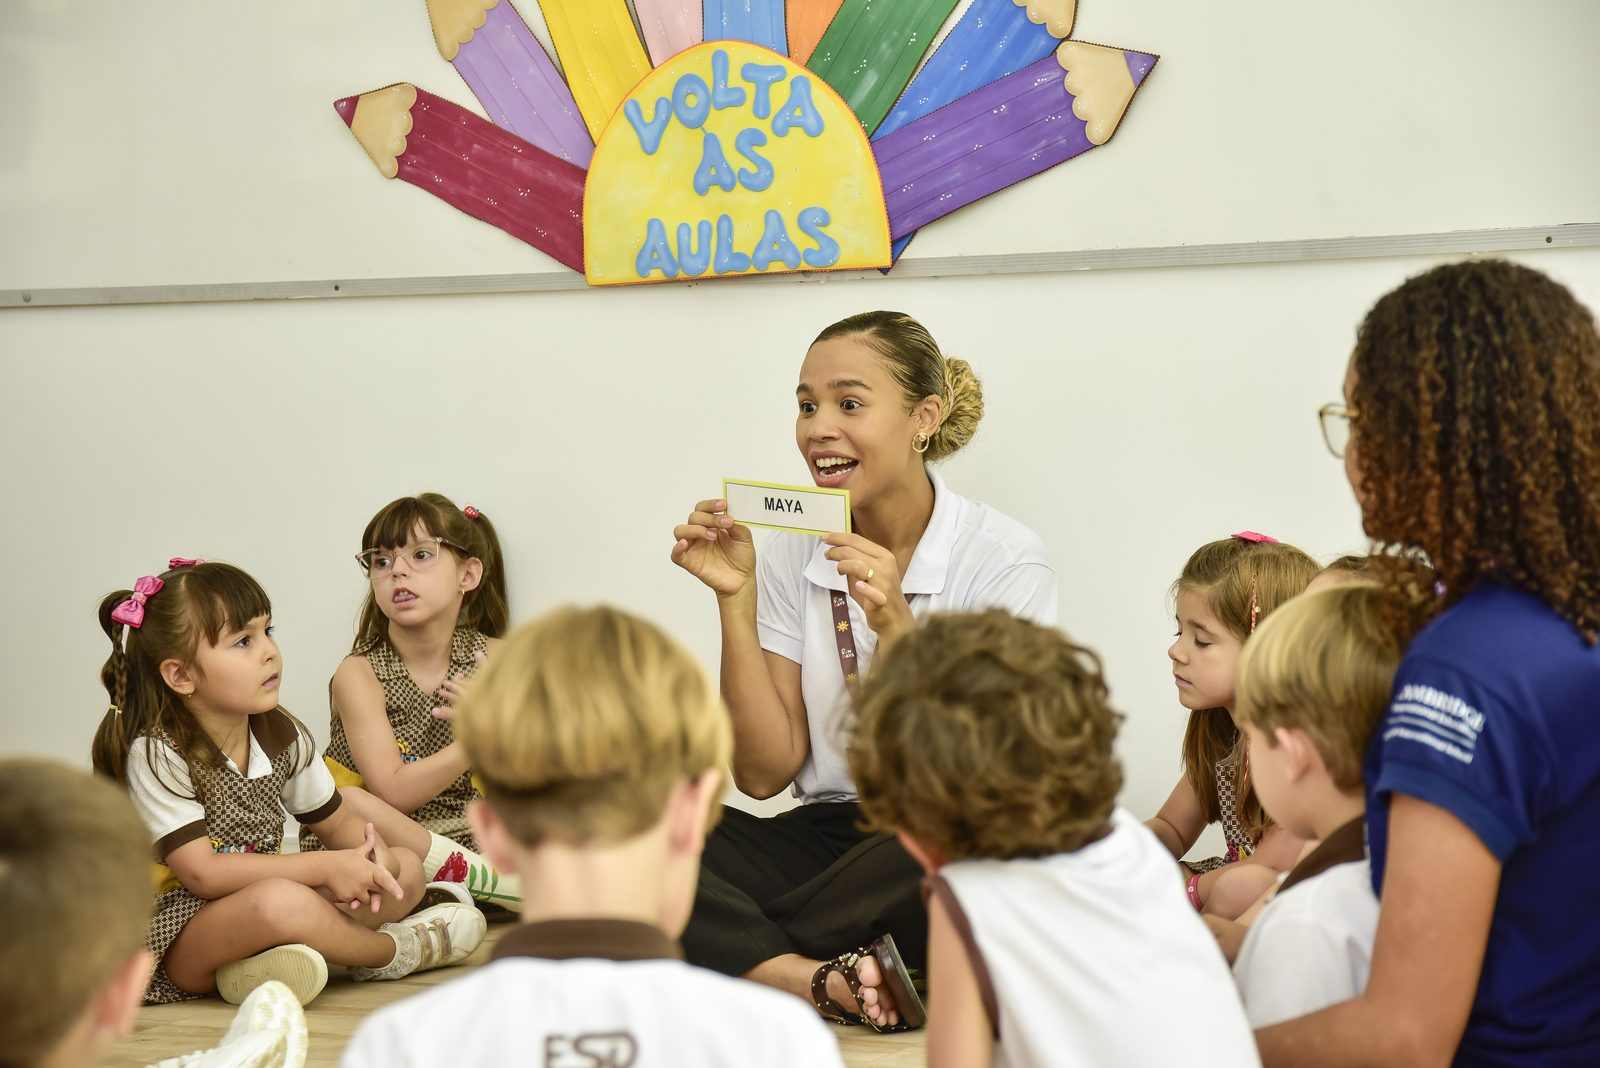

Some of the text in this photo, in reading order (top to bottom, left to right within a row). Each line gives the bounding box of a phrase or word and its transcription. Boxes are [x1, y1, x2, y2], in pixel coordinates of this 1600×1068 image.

[624, 49, 825, 156] VOLTA
[635, 206, 841, 279] AULAS
[764, 496, 804, 514] MAYA
